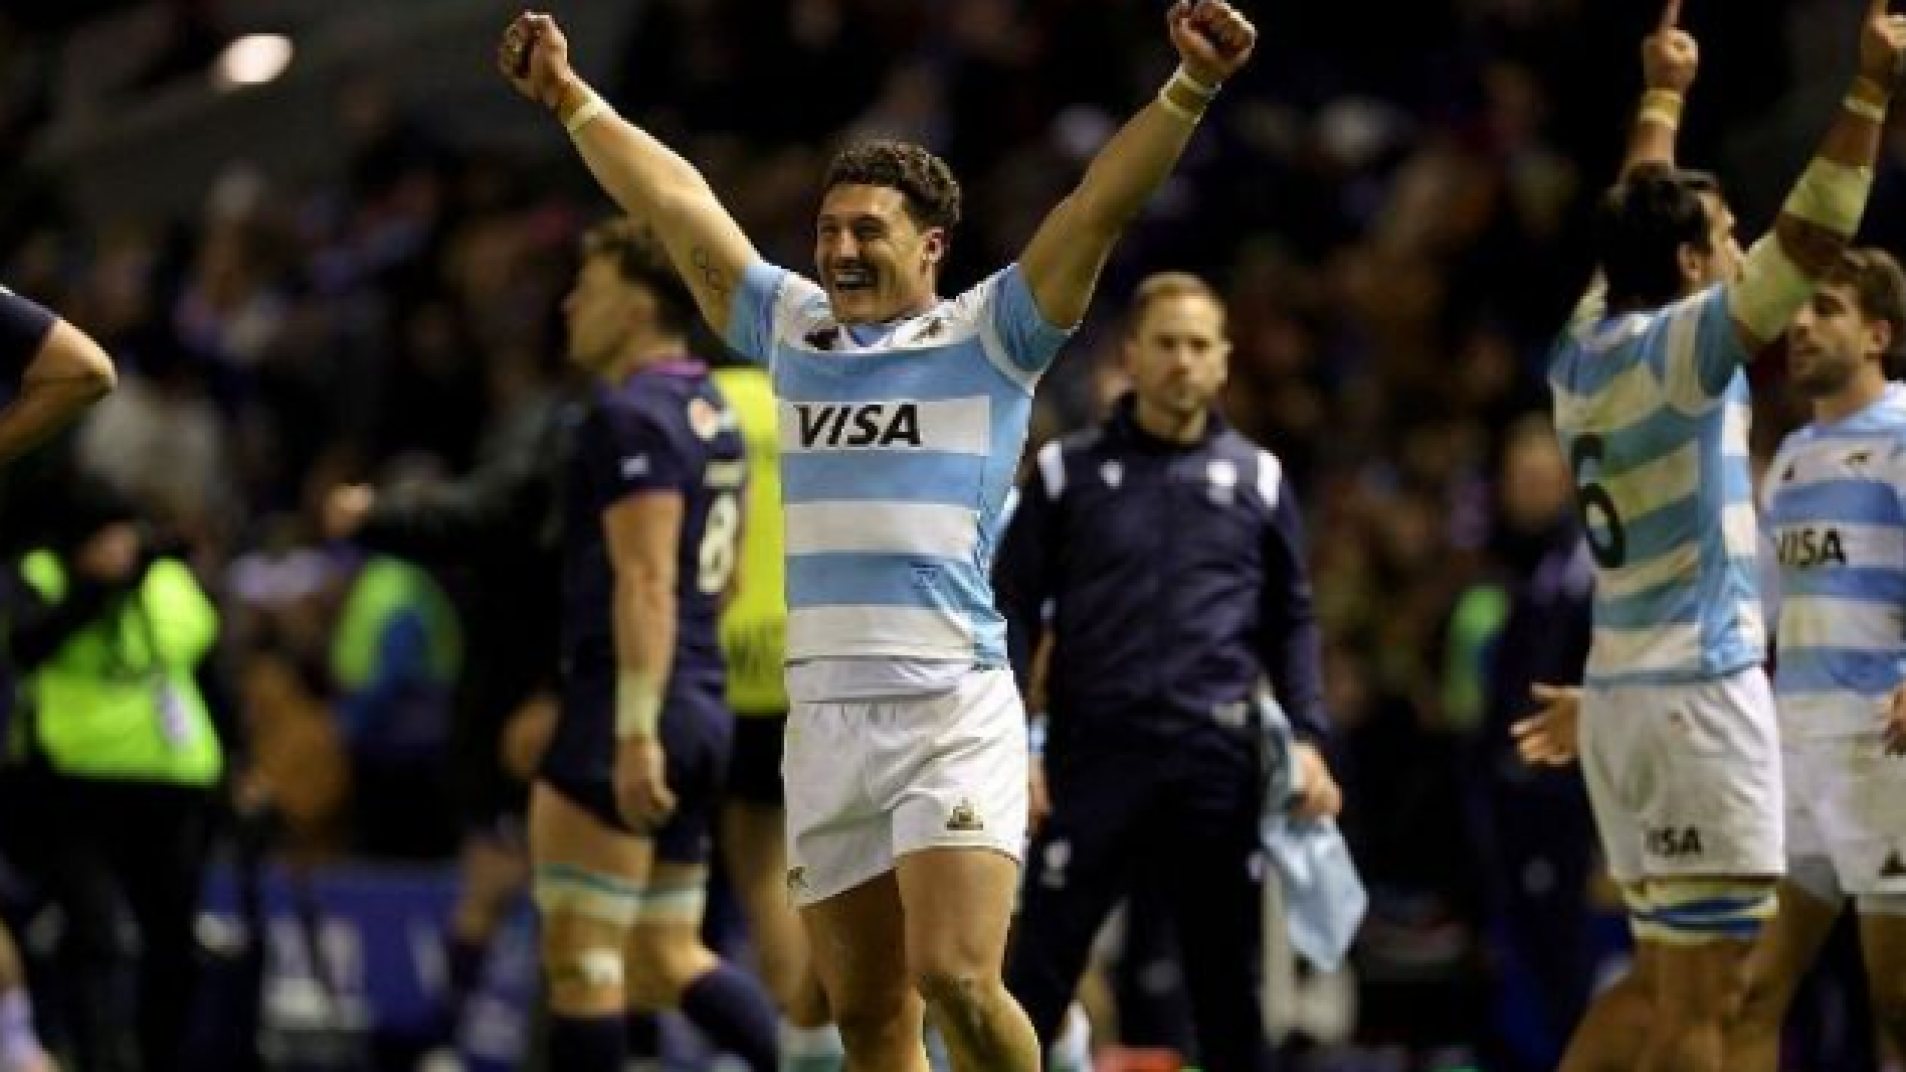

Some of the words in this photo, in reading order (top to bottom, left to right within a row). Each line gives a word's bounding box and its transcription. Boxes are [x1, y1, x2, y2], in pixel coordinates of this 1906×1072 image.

[793, 404, 922, 447] VISA
[697, 491, 739, 594] 8
[1569, 432, 1626, 569] 6
